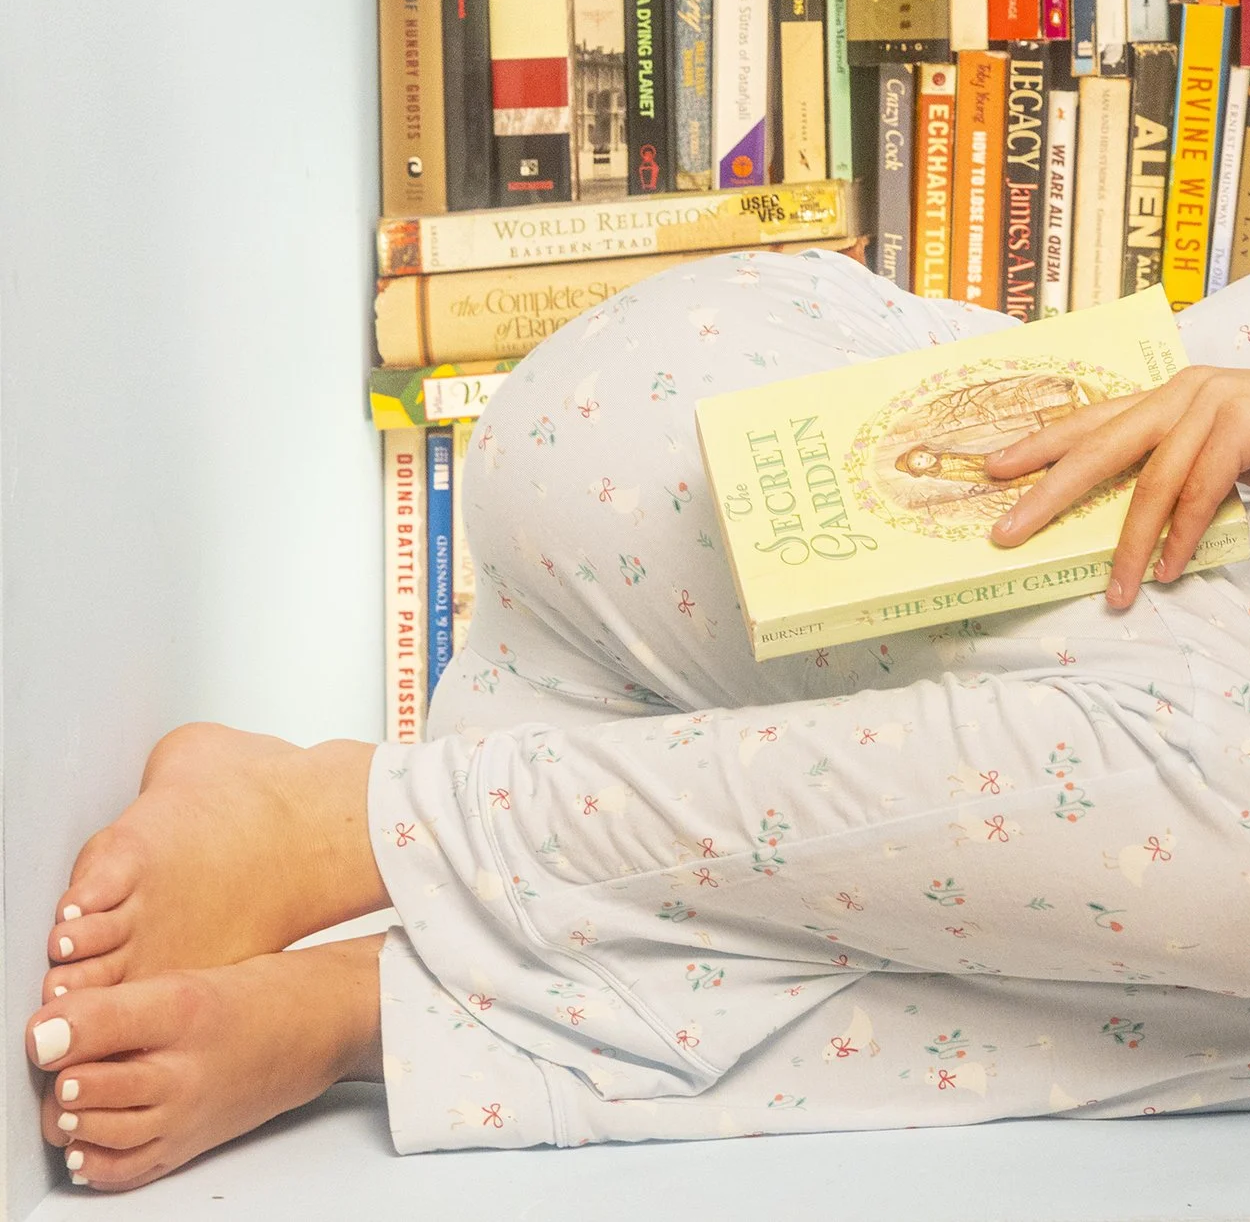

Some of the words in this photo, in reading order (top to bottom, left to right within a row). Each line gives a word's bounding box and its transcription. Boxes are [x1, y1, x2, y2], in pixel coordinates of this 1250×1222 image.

[404, 19, 420, 76] HUNGRY
[637, 8, 652, 54] DYING
[406, 84, 420, 139] GHOSTS
[639, 60, 654, 118] PLANET
[881, 79, 904, 126] Crazy
[1008, 61, 1043, 171] LEGACY
[1181, 66, 1212, 161] IRVINE
[883, 131, 904, 171] Cock
[925, 105, 949, 221] ECKHART
[740, 194, 780, 215] USED
[1127, 114, 1166, 247] ALIEN
[494, 217, 586, 242] WORLD
[1172, 179, 1206, 272] WELSH
[924, 228, 945, 298] TOLLE
[398, 454, 413, 515] DOING
[725, 483, 753, 522] The
[748, 430, 809, 566] SECRET
[789, 415, 878, 561] GARDEN
[398, 525, 414, 594] BATTLE
[879, 602, 926, 621] THE
[932, 580, 1018, 611] SECRET
[399, 612, 414, 659] PAUL
[762, 622, 824, 643] BURNETT
